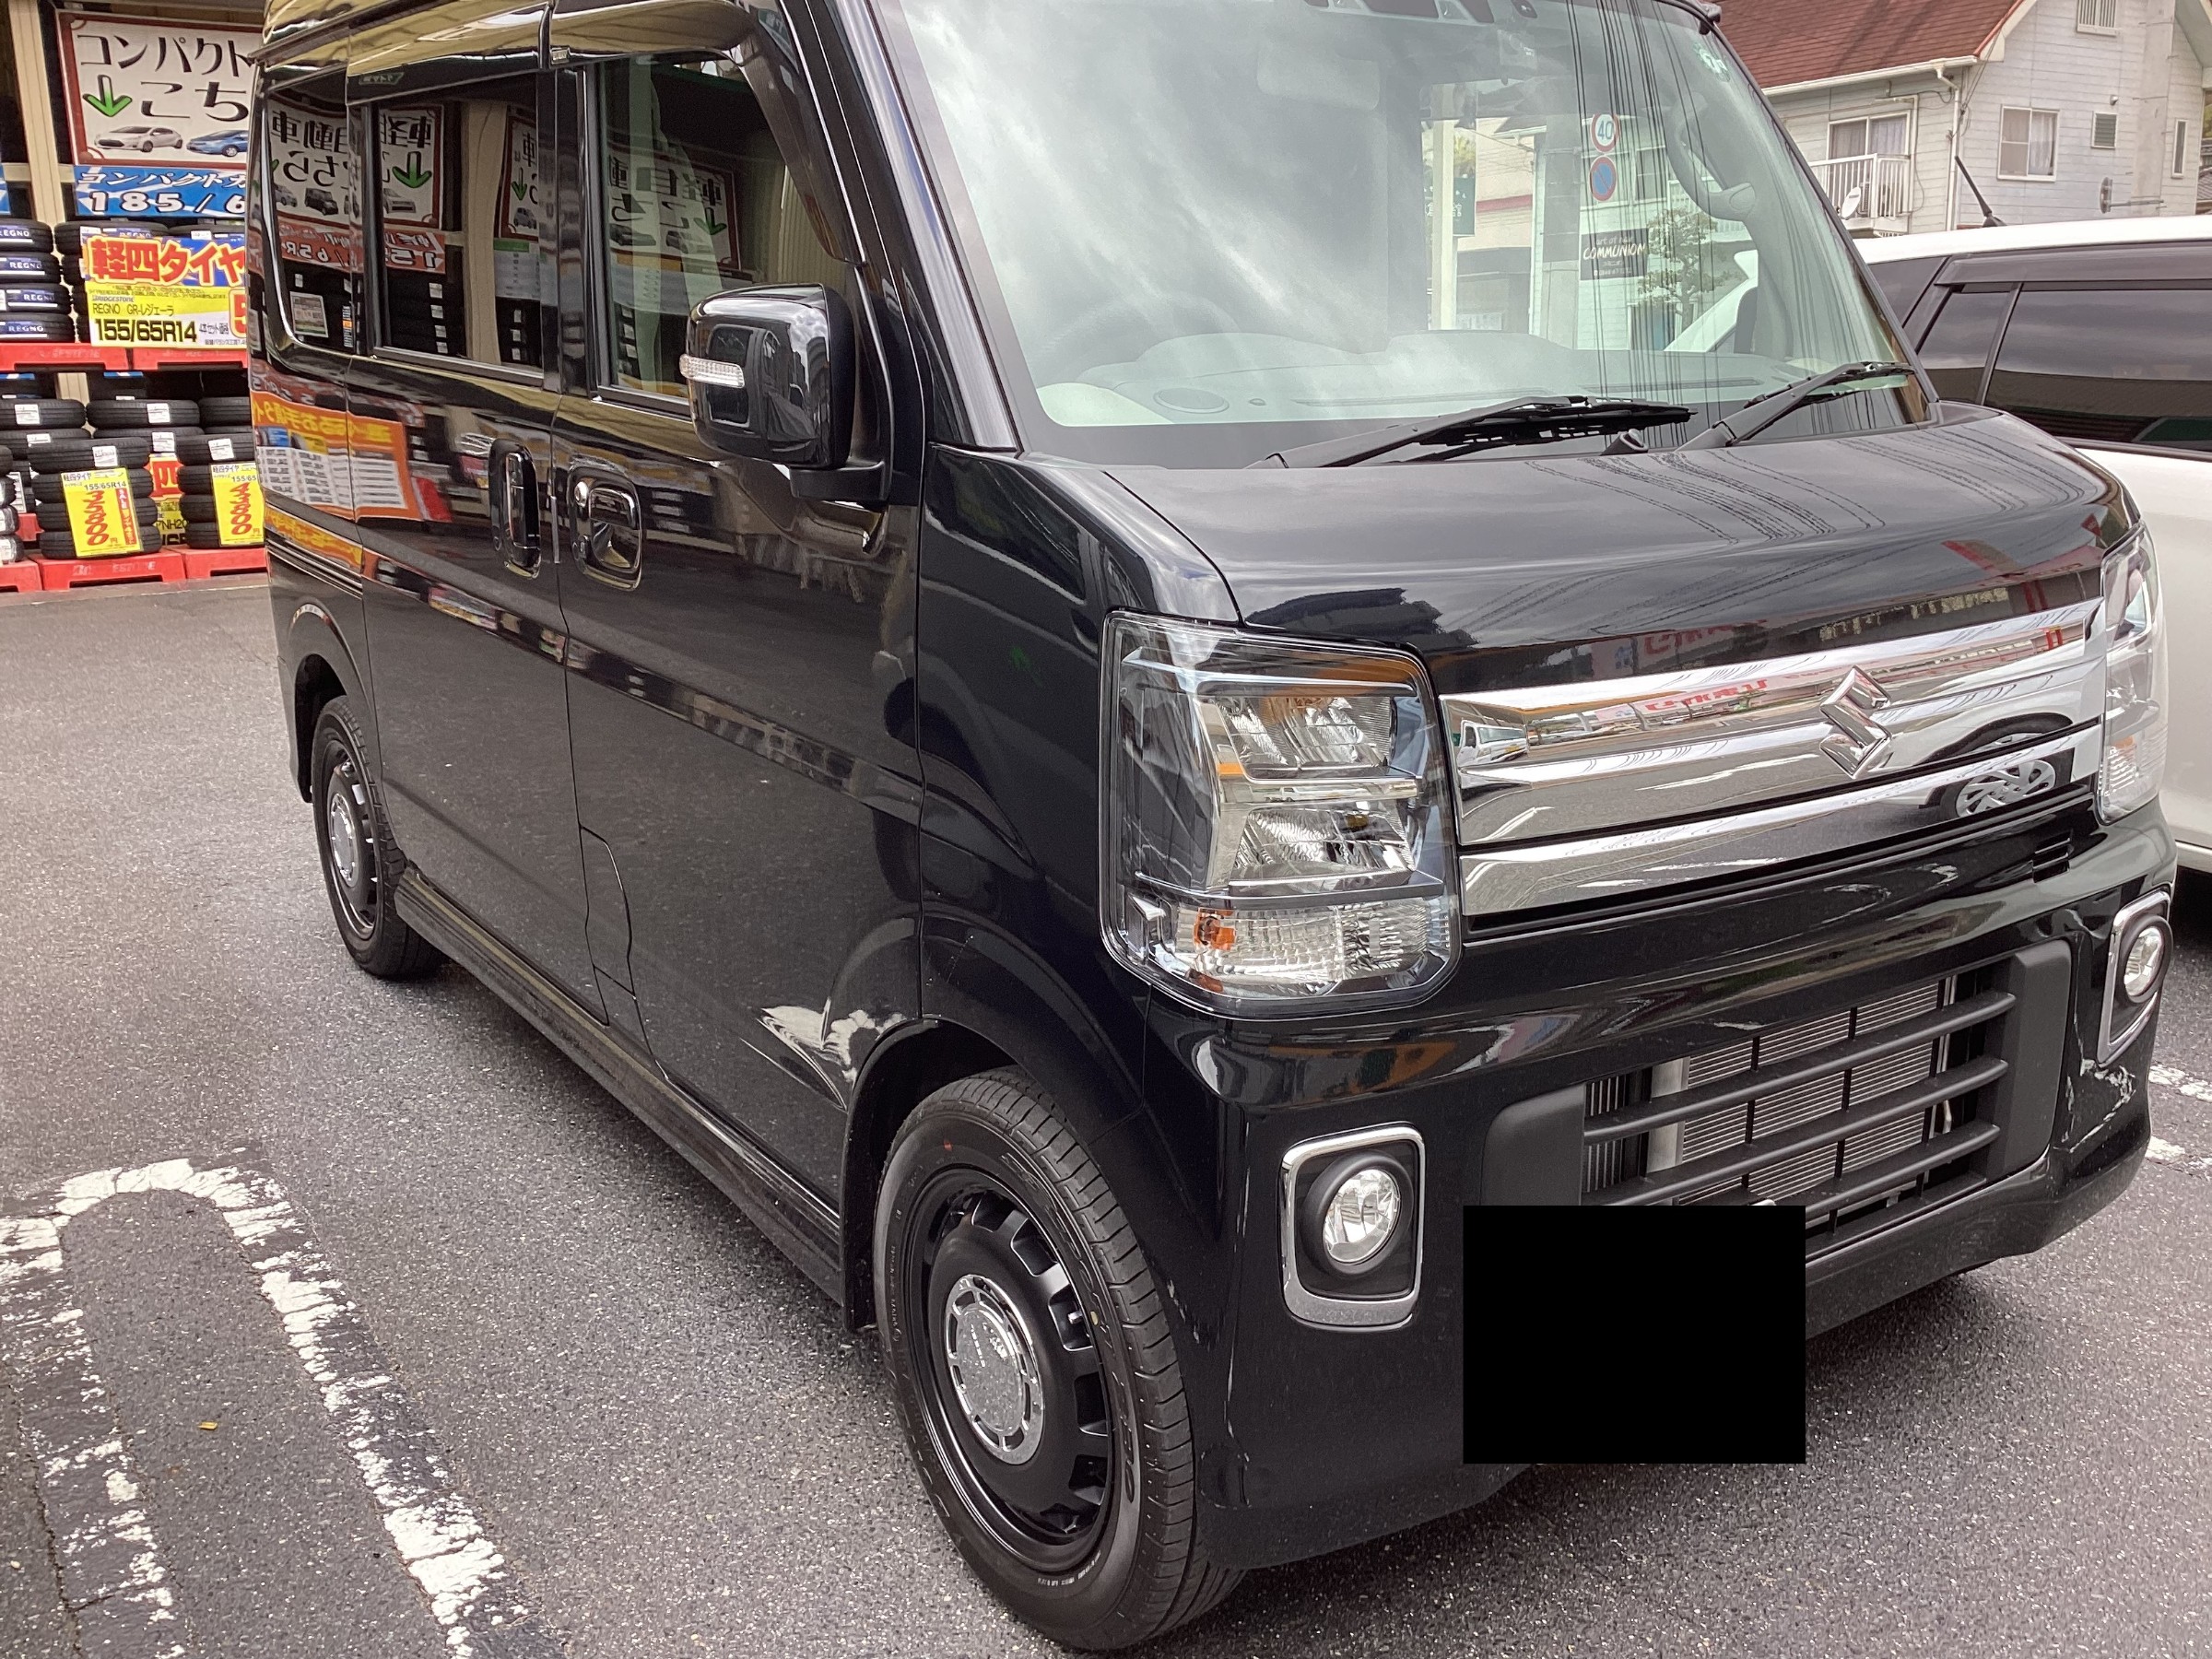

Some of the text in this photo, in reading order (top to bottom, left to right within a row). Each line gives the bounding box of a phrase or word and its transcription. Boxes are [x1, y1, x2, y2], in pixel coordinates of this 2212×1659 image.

[77, 34, 253, 77] コンパクト
[140, 81, 249, 122] こち
[1597, 120, 1614, 139] 40
[90, 239, 246, 284] 軽四タイヤ
[1583, 242, 1646, 261] COMMUNION
[93, 303, 121, 314] REGNO
[95, 319, 197, 342] 155/65R14
[84, 481, 127, 490] 155/65R14
